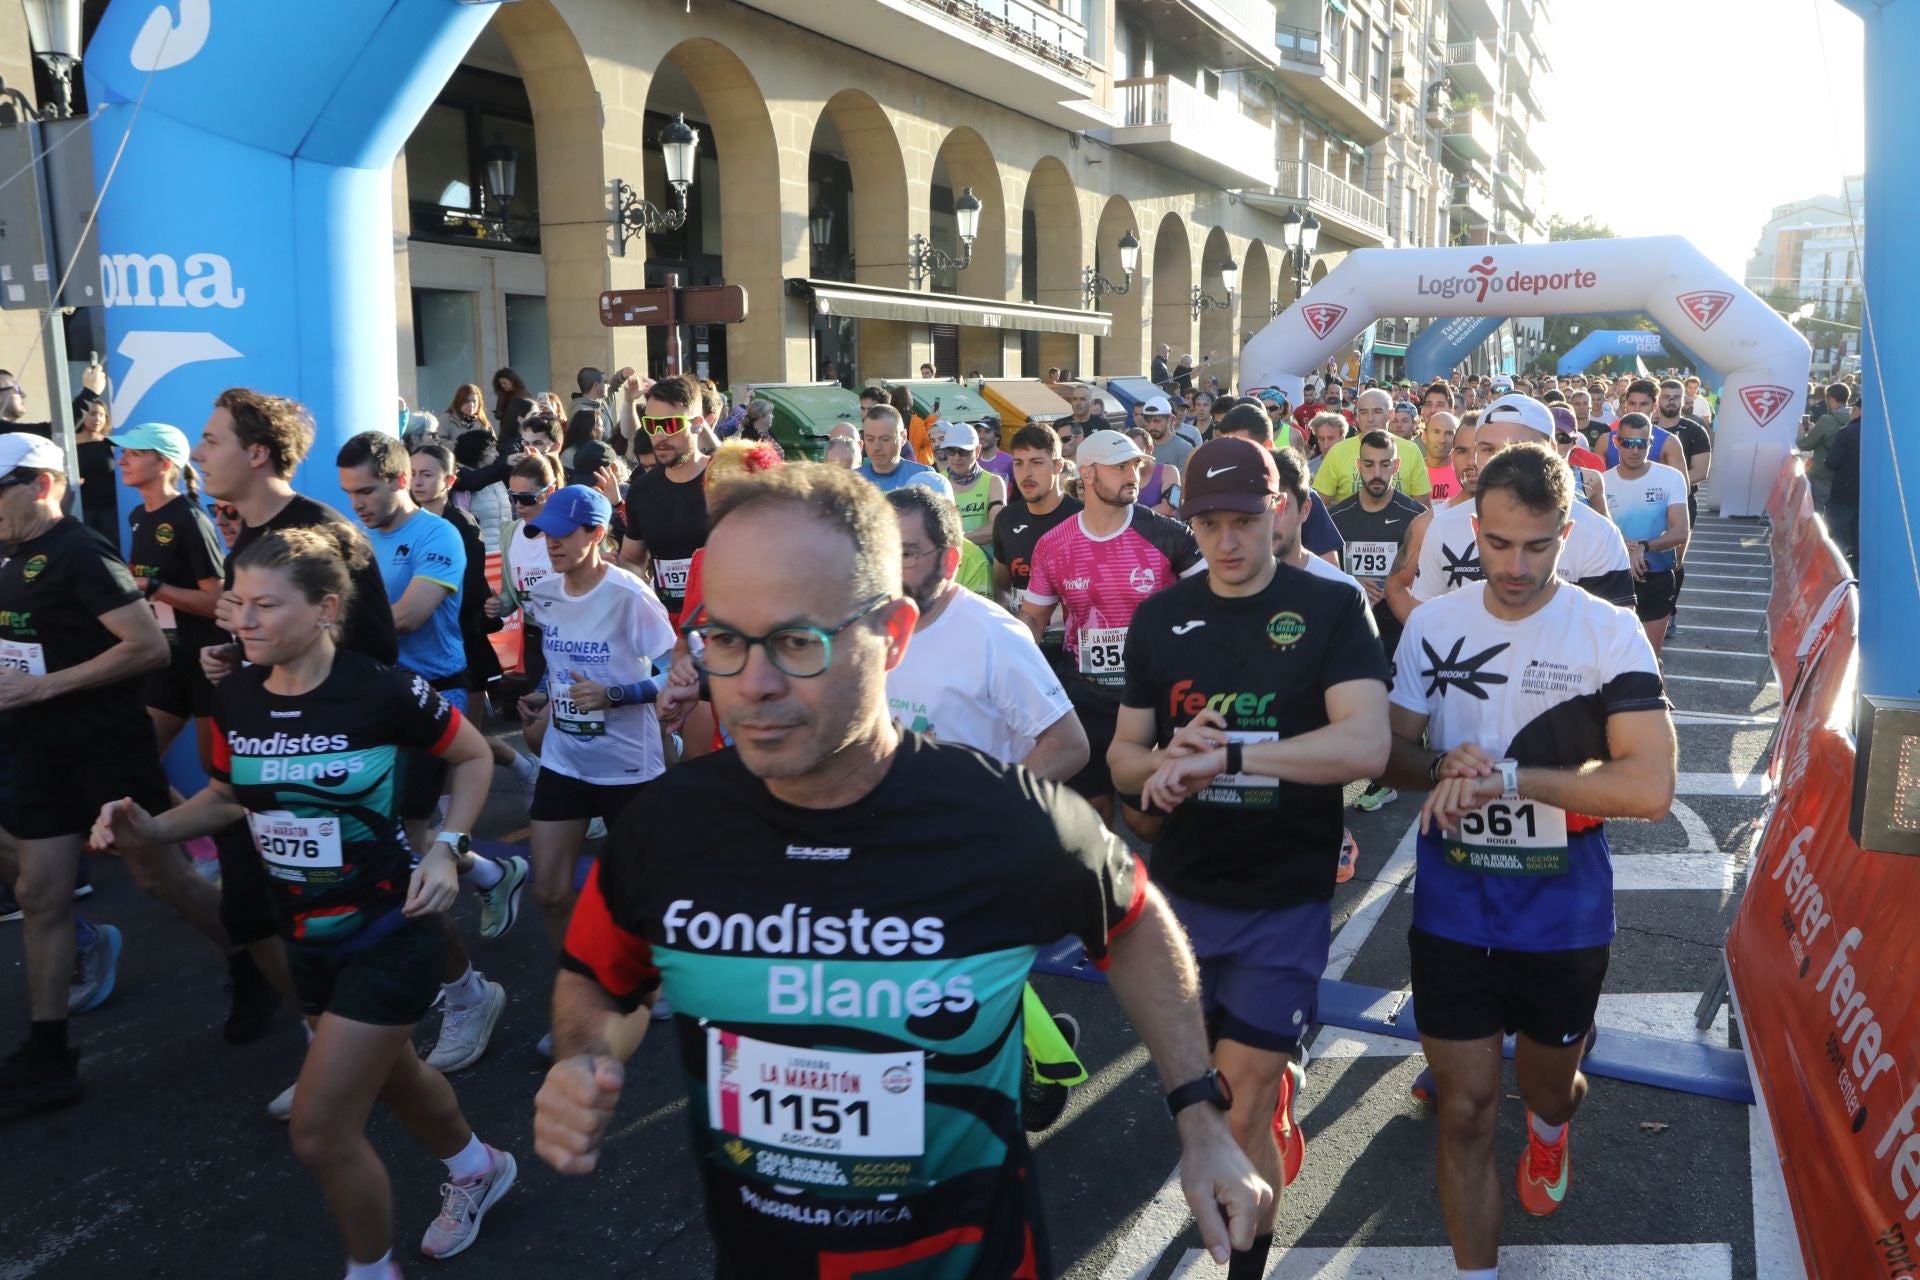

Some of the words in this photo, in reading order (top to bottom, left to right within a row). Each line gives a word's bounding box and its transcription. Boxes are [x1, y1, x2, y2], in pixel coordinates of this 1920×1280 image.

[100, 253, 245, 308] oma
[1506, 268, 1597, 296] deporte
[1617, 334, 1661, 344] POWER
[1636, 343, 1660, 352] ADE
[1352, 555, 1387, 571] 793
[544, 640, 610, 653] MELONERA
[1093, 636, 1101, 644] LA
[1102, 632, 1127, 644] MARATÓ
[1091, 644, 1124, 667] 35
[1437, 670, 1470, 680] BROOKS
[1236, 717, 1266, 727] sport
[228, 730, 349, 756] Fondistes
[261, 756, 366, 782] Blanes
[1463, 803, 1536, 838] 561
[261, 834, 319, 859] 2076
[1470, 852, 1490, 862] CAJA
[1491, 853, 1519, 862] RURAL
[1484, 860, 1523, 869] NAVARRA
[662, 899, 945, 956] Fondistes
[767, 962, 976, 1018] Blanes
[760, 1063, 779, 1085] LA
[784, 1069, 862, 1094] MARATÓN
[1838, 1067, 1861, 1118] center
[749, 1088, 870, 1138] 1151
